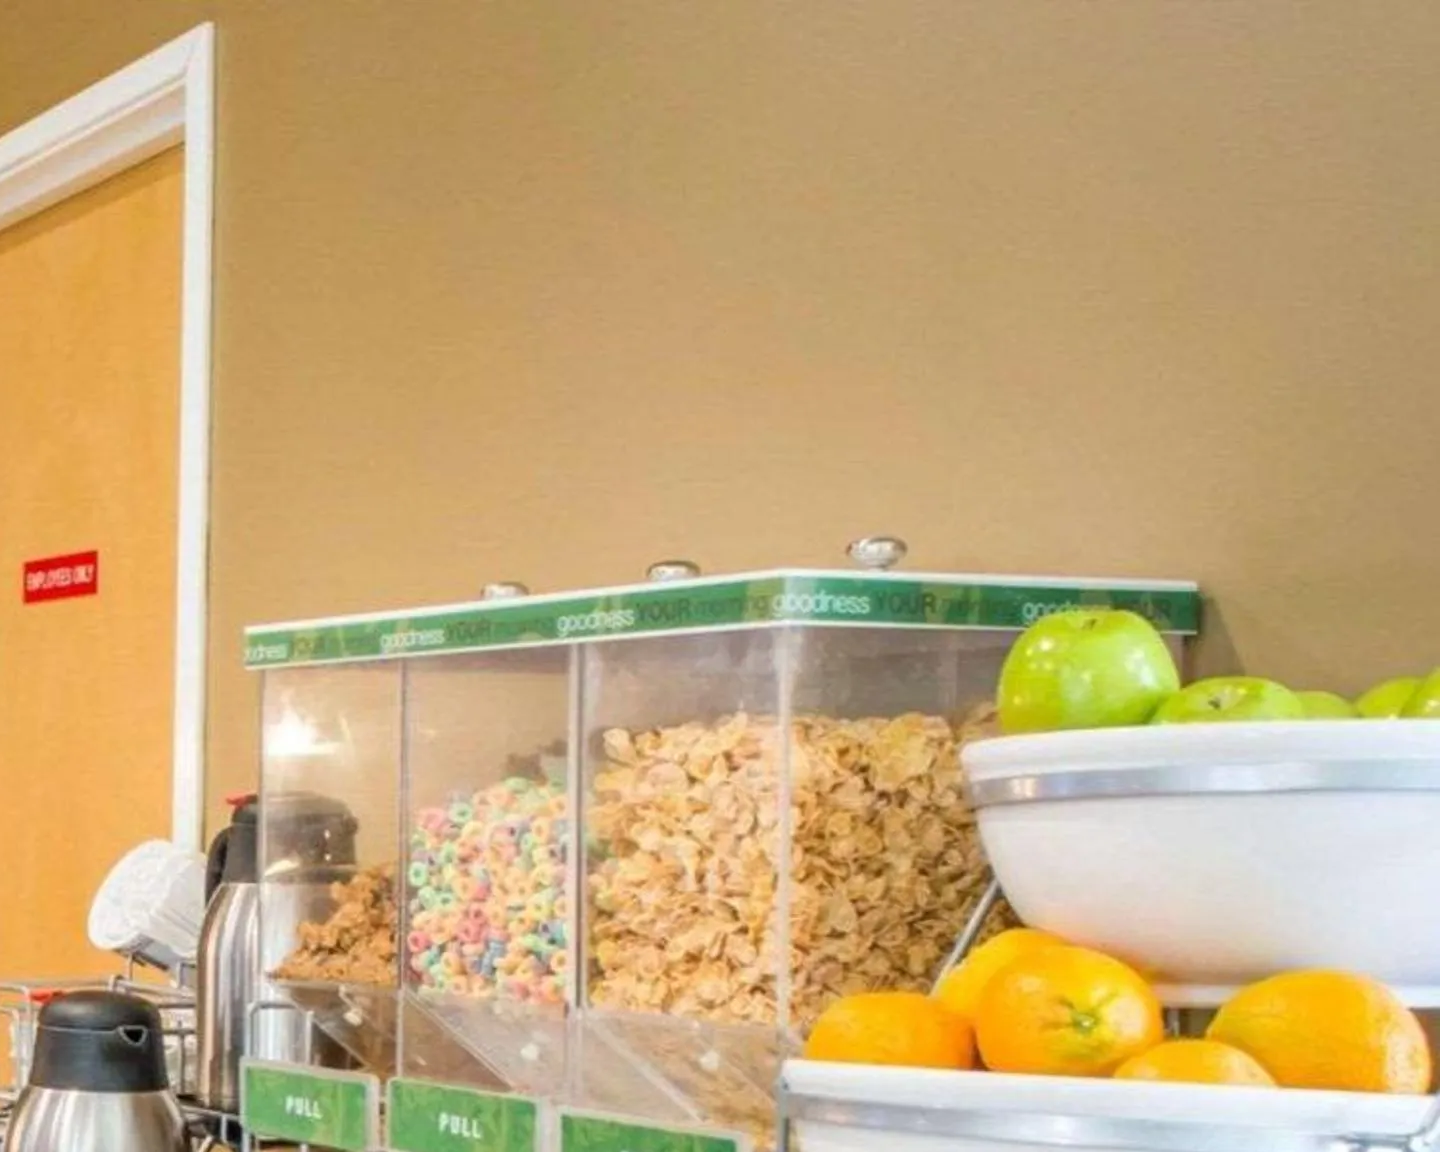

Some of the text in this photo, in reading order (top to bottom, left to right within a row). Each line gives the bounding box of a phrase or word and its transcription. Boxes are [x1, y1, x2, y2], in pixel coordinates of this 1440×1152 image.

[772, 588, 871, 618] goodness
[380, 628, 445, 655] goodness
[557, 608, 635, 638] goodness
[636, 597, 691, 626] YOUR
[285, 1095, 323, 1121] PULL
[438, 1112, 483, 1139] PULL
